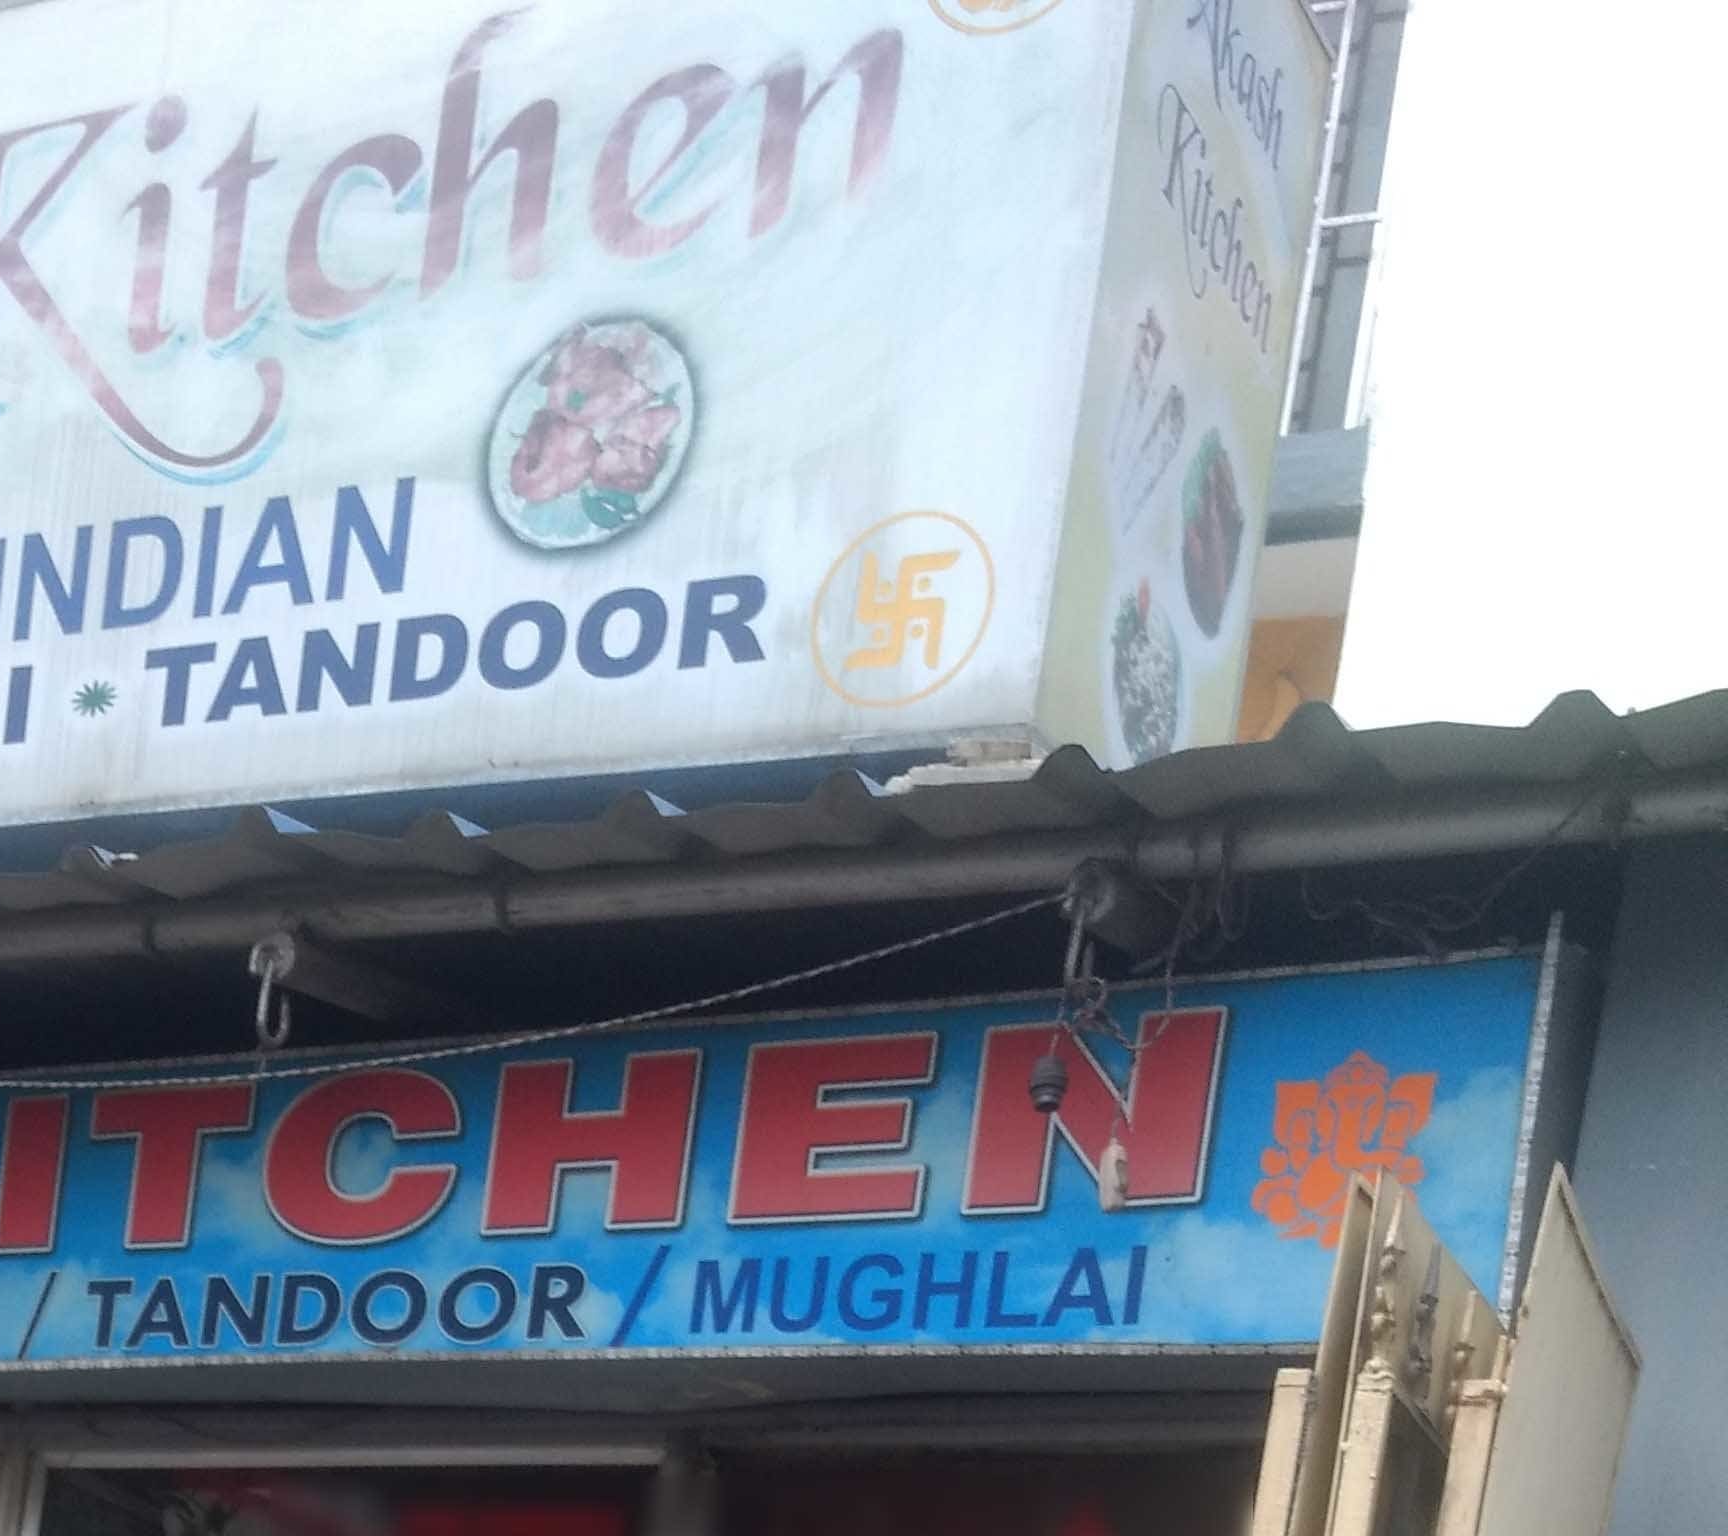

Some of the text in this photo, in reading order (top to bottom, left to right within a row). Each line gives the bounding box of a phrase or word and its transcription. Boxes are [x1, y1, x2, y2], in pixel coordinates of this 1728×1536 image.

[1185, 0, 1284, 171] Akash
[1157, 83, 1273, 355] Kitchen
[144, 574, 768, 728] TANDOOR
[86, 1262, 588, 1352] TANDOOR
[687, 1244, 1148, 1337] MUGHLAI
